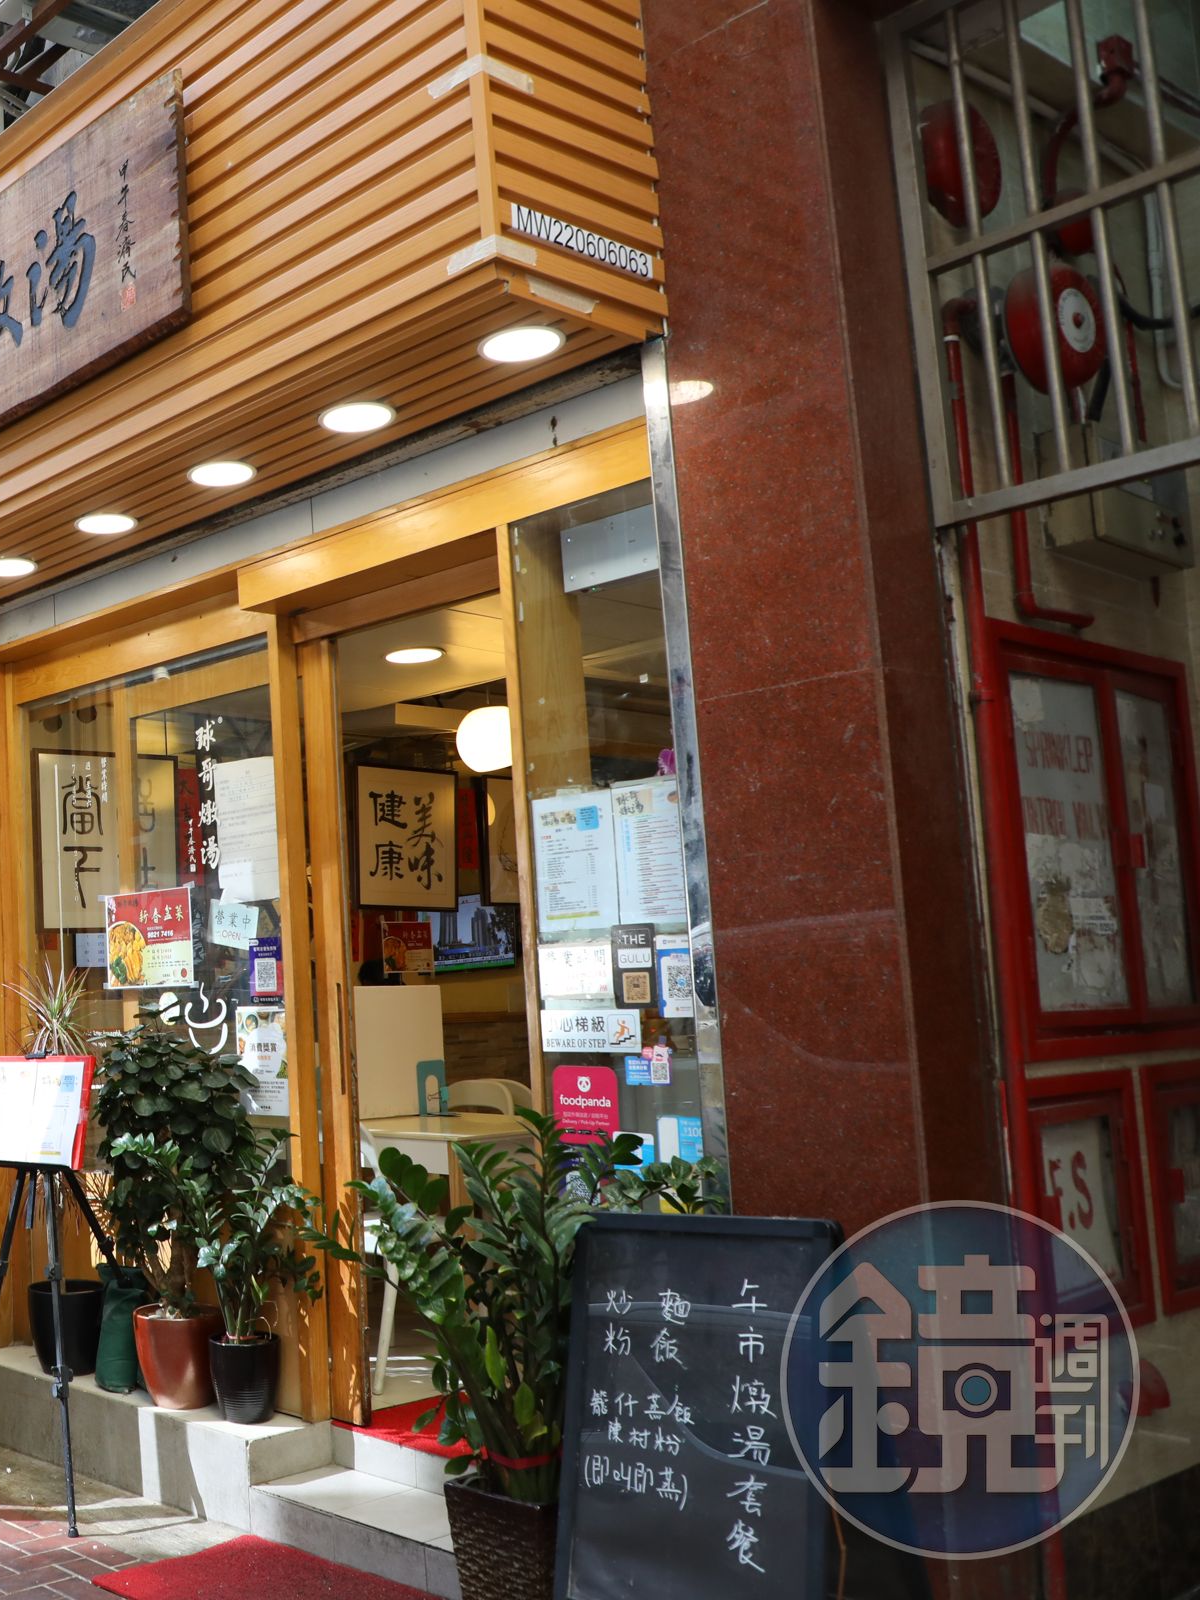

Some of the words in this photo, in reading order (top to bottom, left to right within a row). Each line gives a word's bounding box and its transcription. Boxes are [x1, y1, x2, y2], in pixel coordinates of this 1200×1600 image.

[516, 204, 650, 278] MW220606063
[195, 719, 221, 871] 球哥燉湯
[368, 789, 409, 881] 健康
[406, 791, 444, 891] 美味
[221, 929, 242, 941] OPEN
[621, 933, 647, 945] THE
[620, 953, 651, 965] GULU
[546, 1038, 578, 1048] BEWARE
[578, 1038, 589, 1048] OF
[588, 1038, 607, 1048] STEP
[560, 1094, 612, 1109] foodpanda
[725, 1278, 778, 1573] 午市燉湯套餐
